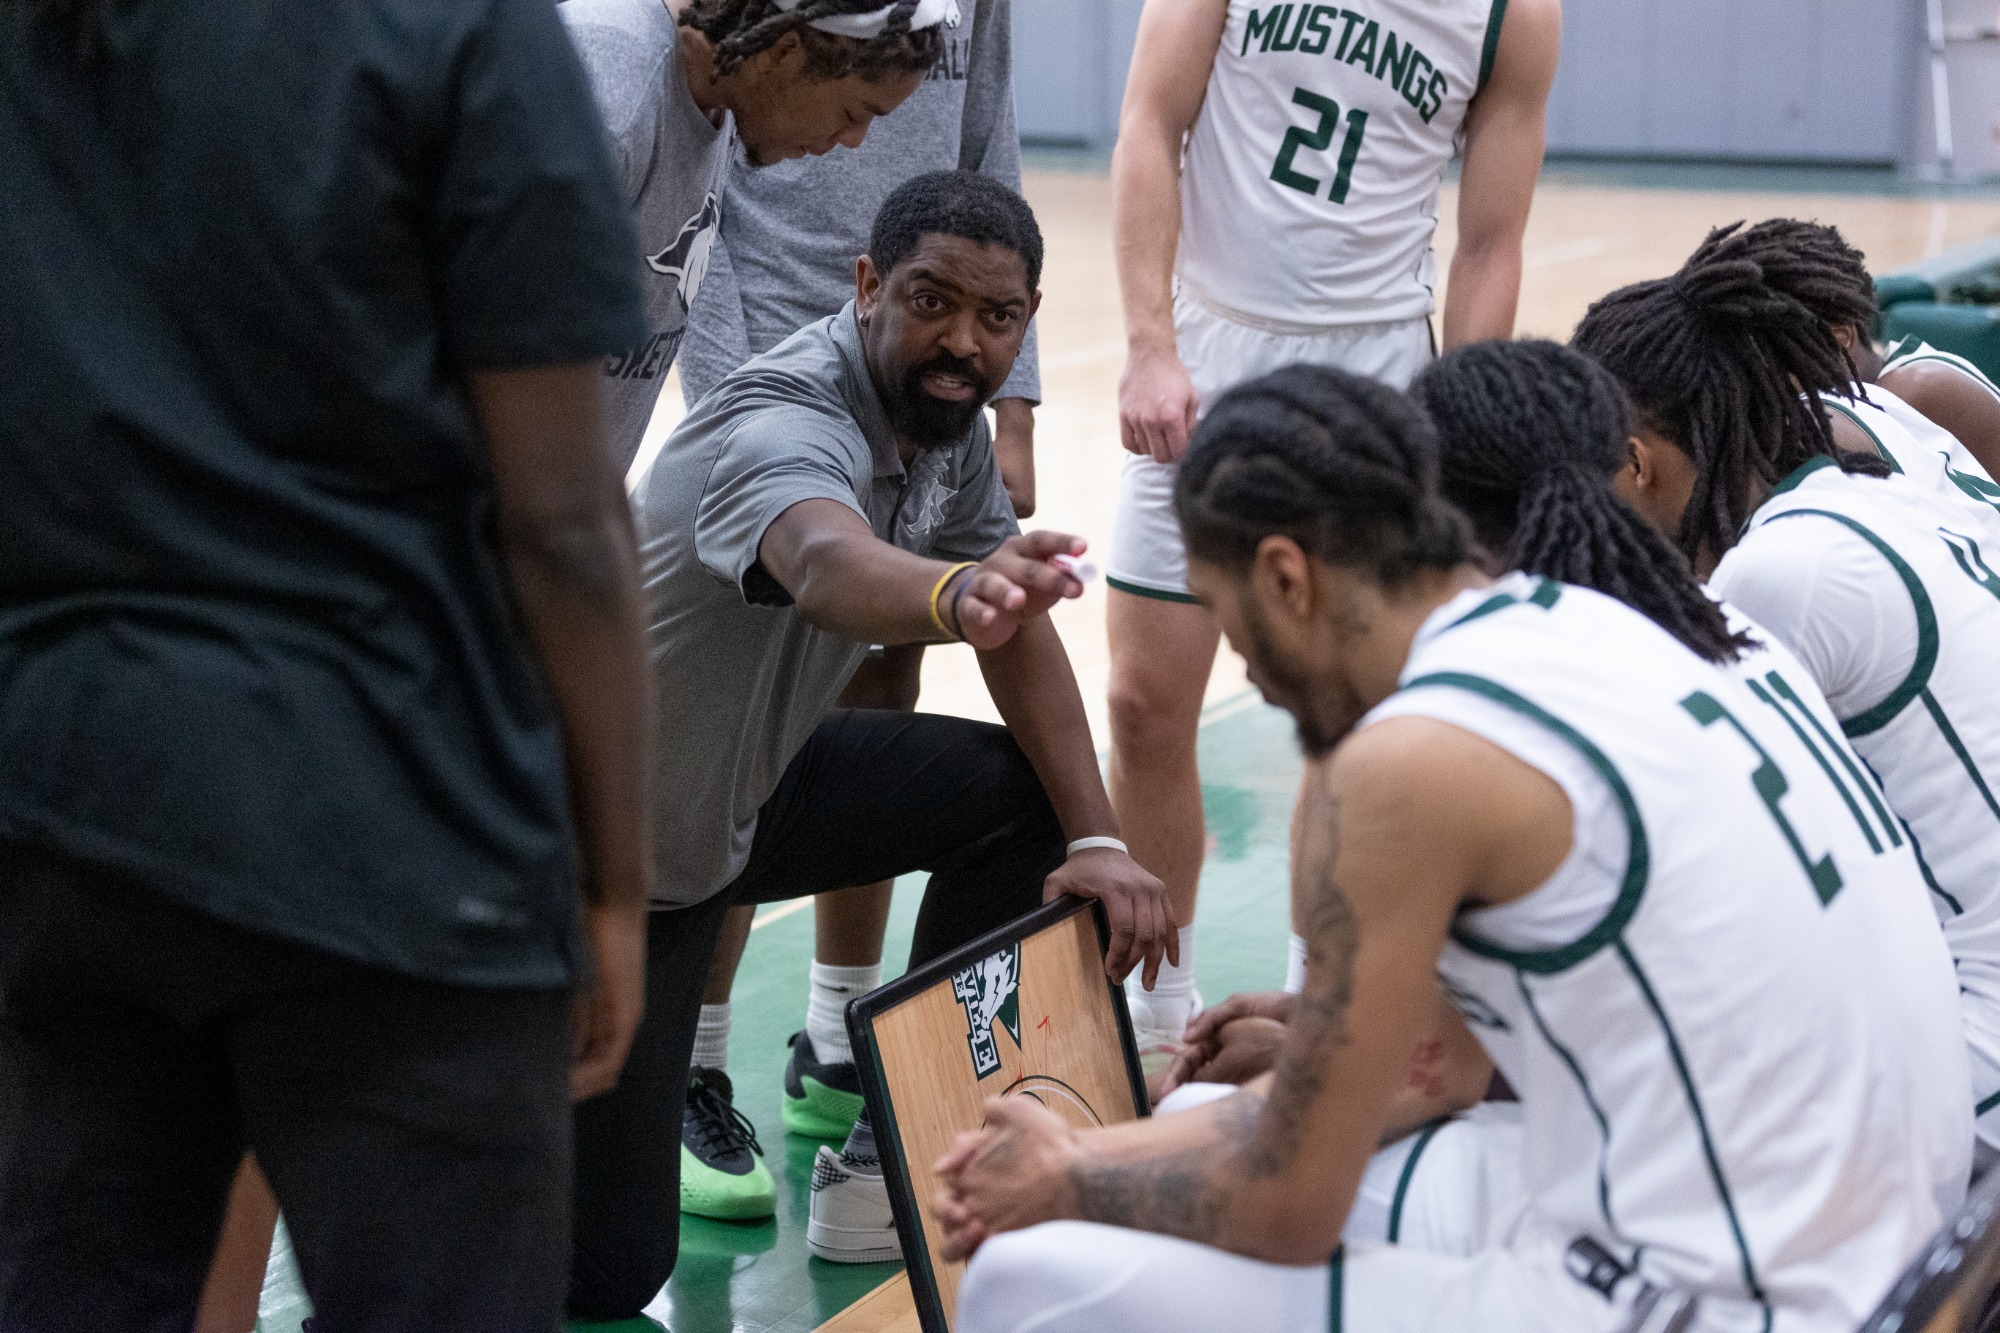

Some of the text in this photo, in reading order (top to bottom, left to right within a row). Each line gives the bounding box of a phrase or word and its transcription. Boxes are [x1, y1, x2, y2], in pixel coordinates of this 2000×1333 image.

[1241, 4, 1447, 125] MUSTANGS
[1269, 87, 1369, 205] 21
[1679, 691, 1844, 908] 2
[1746, 670, 1903, 855] 11
